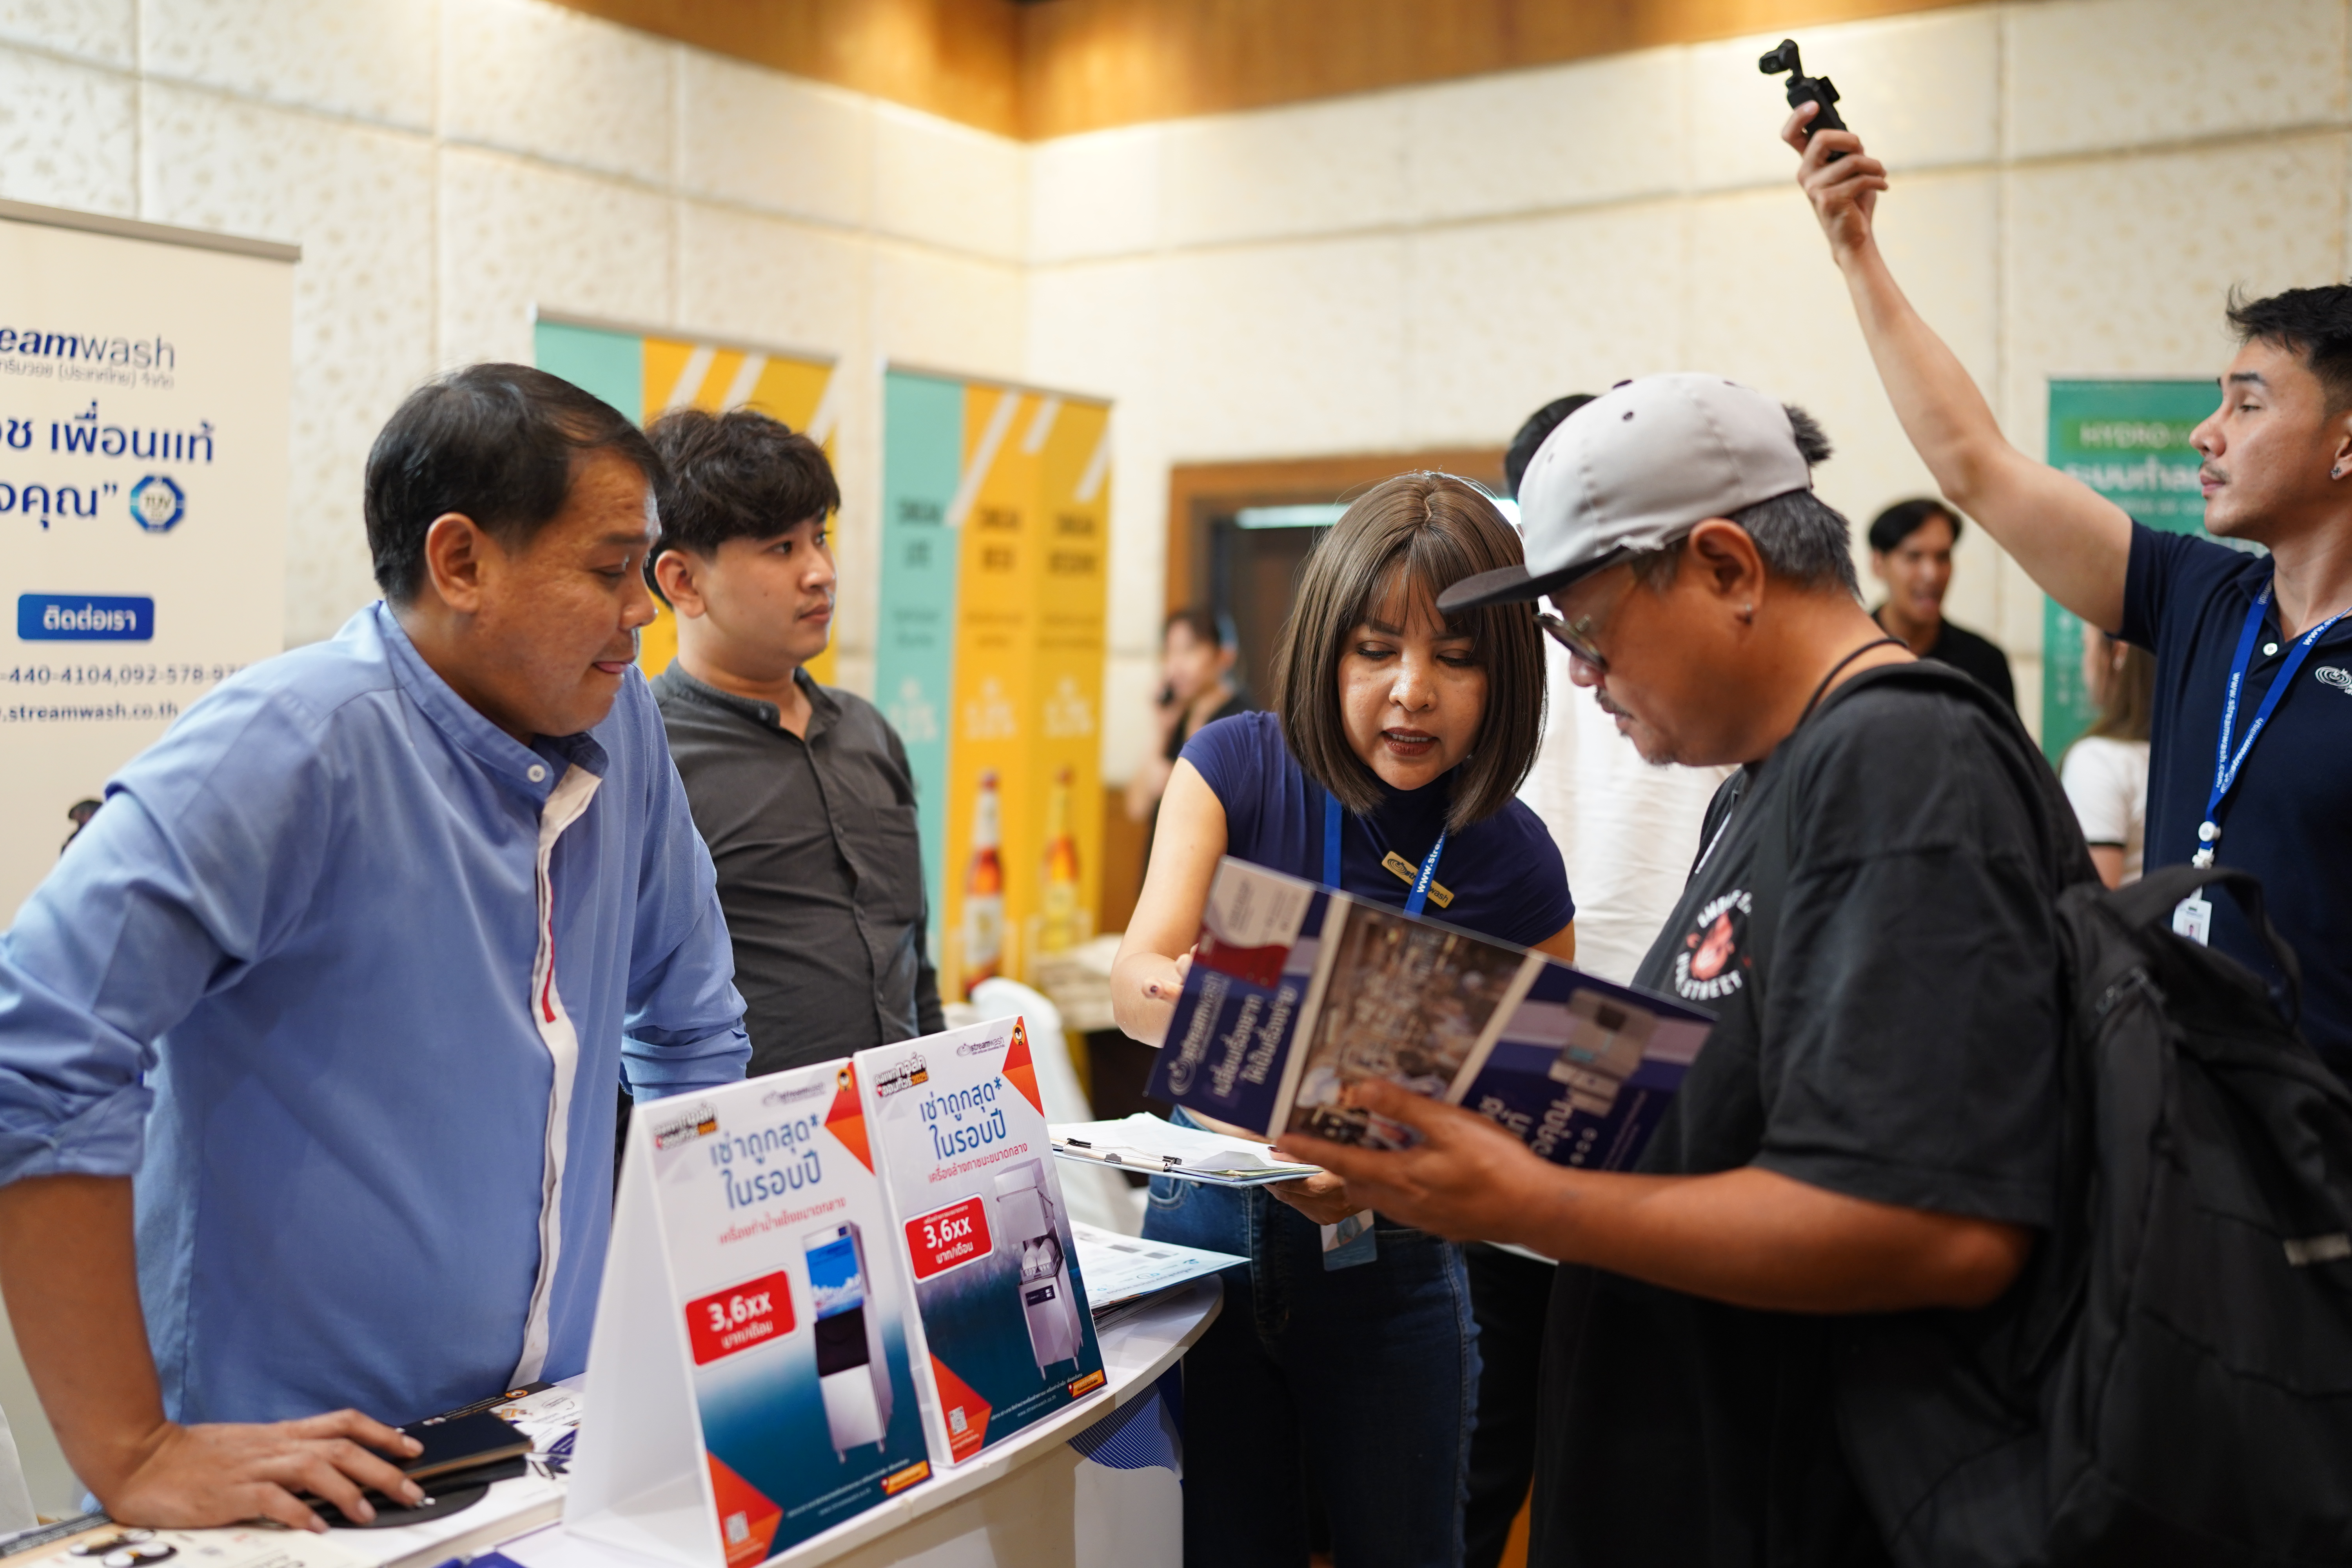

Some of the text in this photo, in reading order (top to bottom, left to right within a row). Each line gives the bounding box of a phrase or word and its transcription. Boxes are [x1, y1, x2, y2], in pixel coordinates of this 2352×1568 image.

[51, 399, 214, 463] เพื่อนแท้
[43, 603, 137, 632] ติดต่อเรา
[0, 702, 178, 722] .streamwash.co.th
[1405, 869, 1449, 903] strwash
[971, 1036, 1005, 1052] streamwash
[929, 1108, 1006, 1160] ในรอบปี
[721, 1149, 822, 1210] ในรอบปี
[927, 1143, 1028, 1184] เครื่องล้างภาชนะขนาดกลาง
[923, 1216, 973, 1249] 3,6xx
[935, 1241, 974, 1265] บาท/เดือน
[707, 1291, 773, 1332] 3,6xx
[721, 1320, 774, 1350] บาท/เดือน
